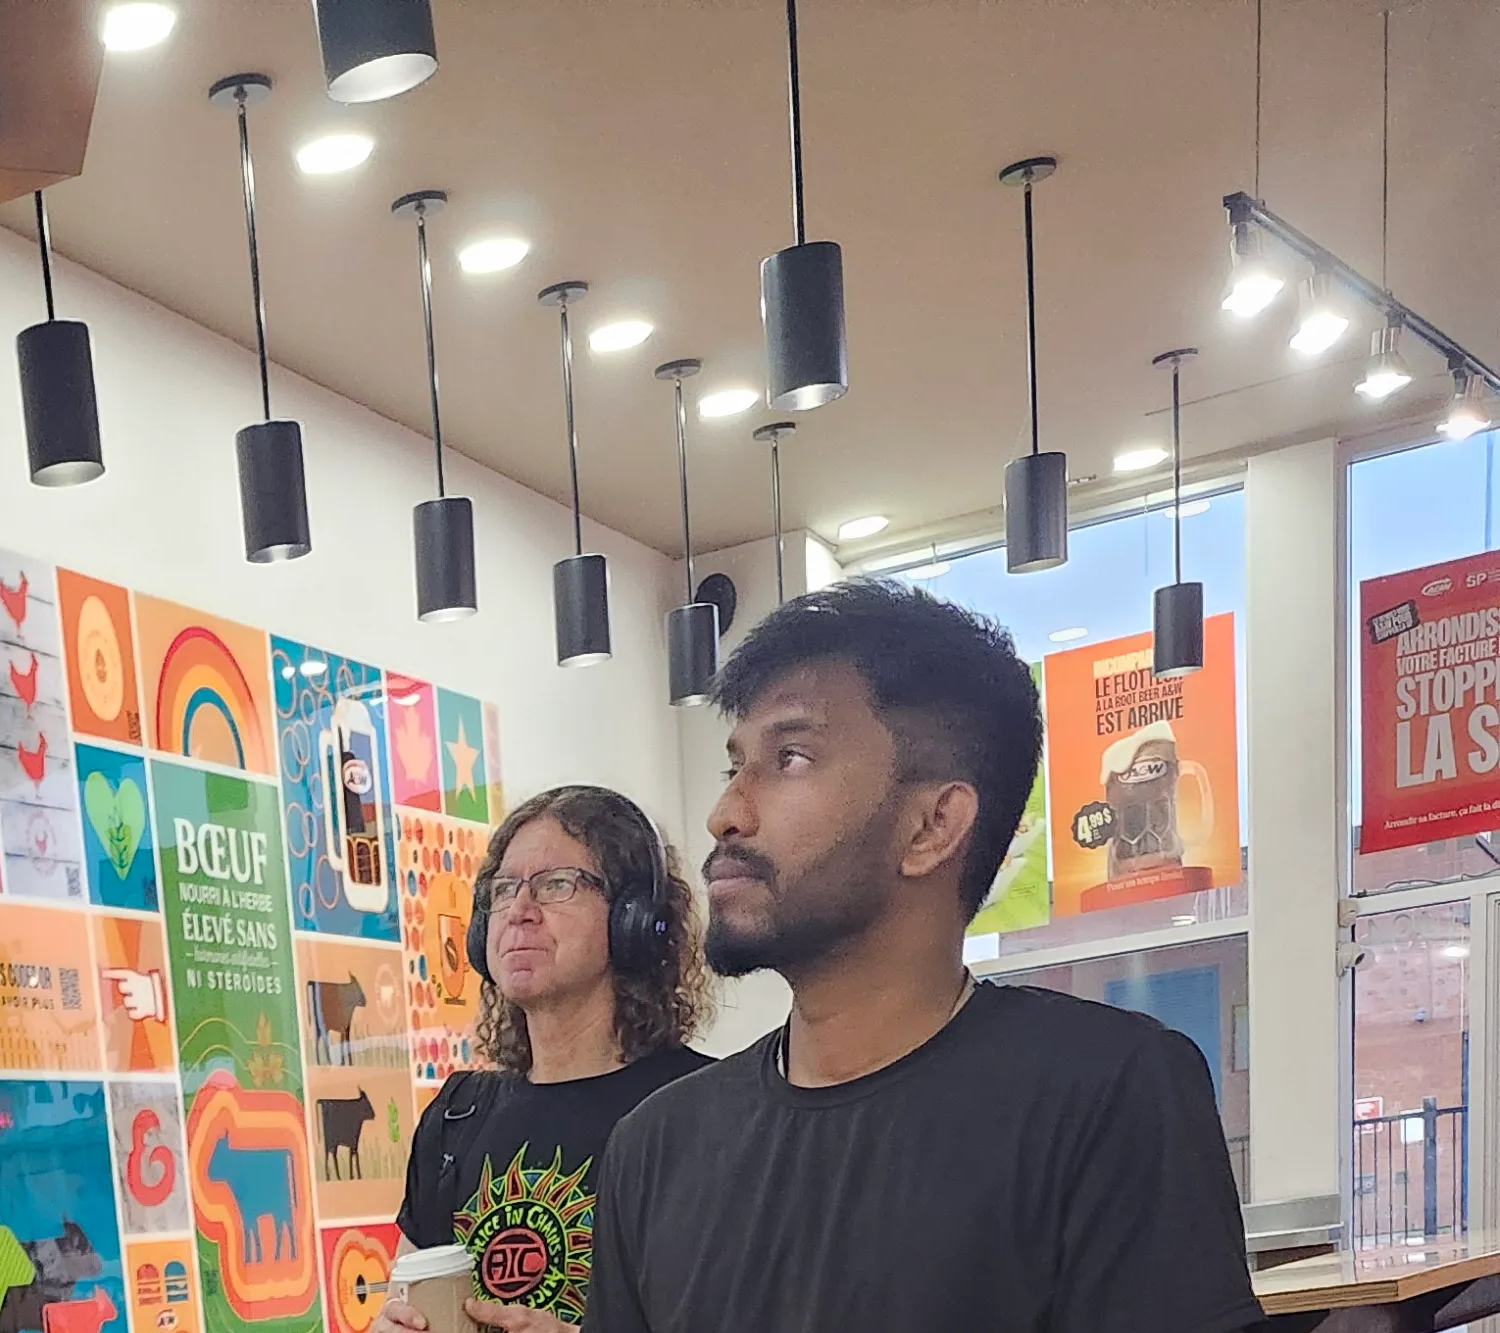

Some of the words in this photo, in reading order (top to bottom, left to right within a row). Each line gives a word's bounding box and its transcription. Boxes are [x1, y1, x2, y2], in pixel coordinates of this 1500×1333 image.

[1397, 607, 1500, 657] ARRONDIS
[1397, 651, 1438, 676] VOTRE
[1440, 638, 1497, 666] FACTURE
[1095, 677, 1113, 698] LE
[1397, 657, 1500, 720] STOPP
[1096, 710, 1126, 736] EST
[1396, 713, 1457, 788] LA
[1468, 704, 1500, 773] S
[174, 818, 267, 884] BŒUF
[179, 882, 221, 906] NOURRI
[182, 908, 236, 945] ÉLEVÉ
[236, 919, 278, 950] SANS
[186, 968, 202, 988] NI
